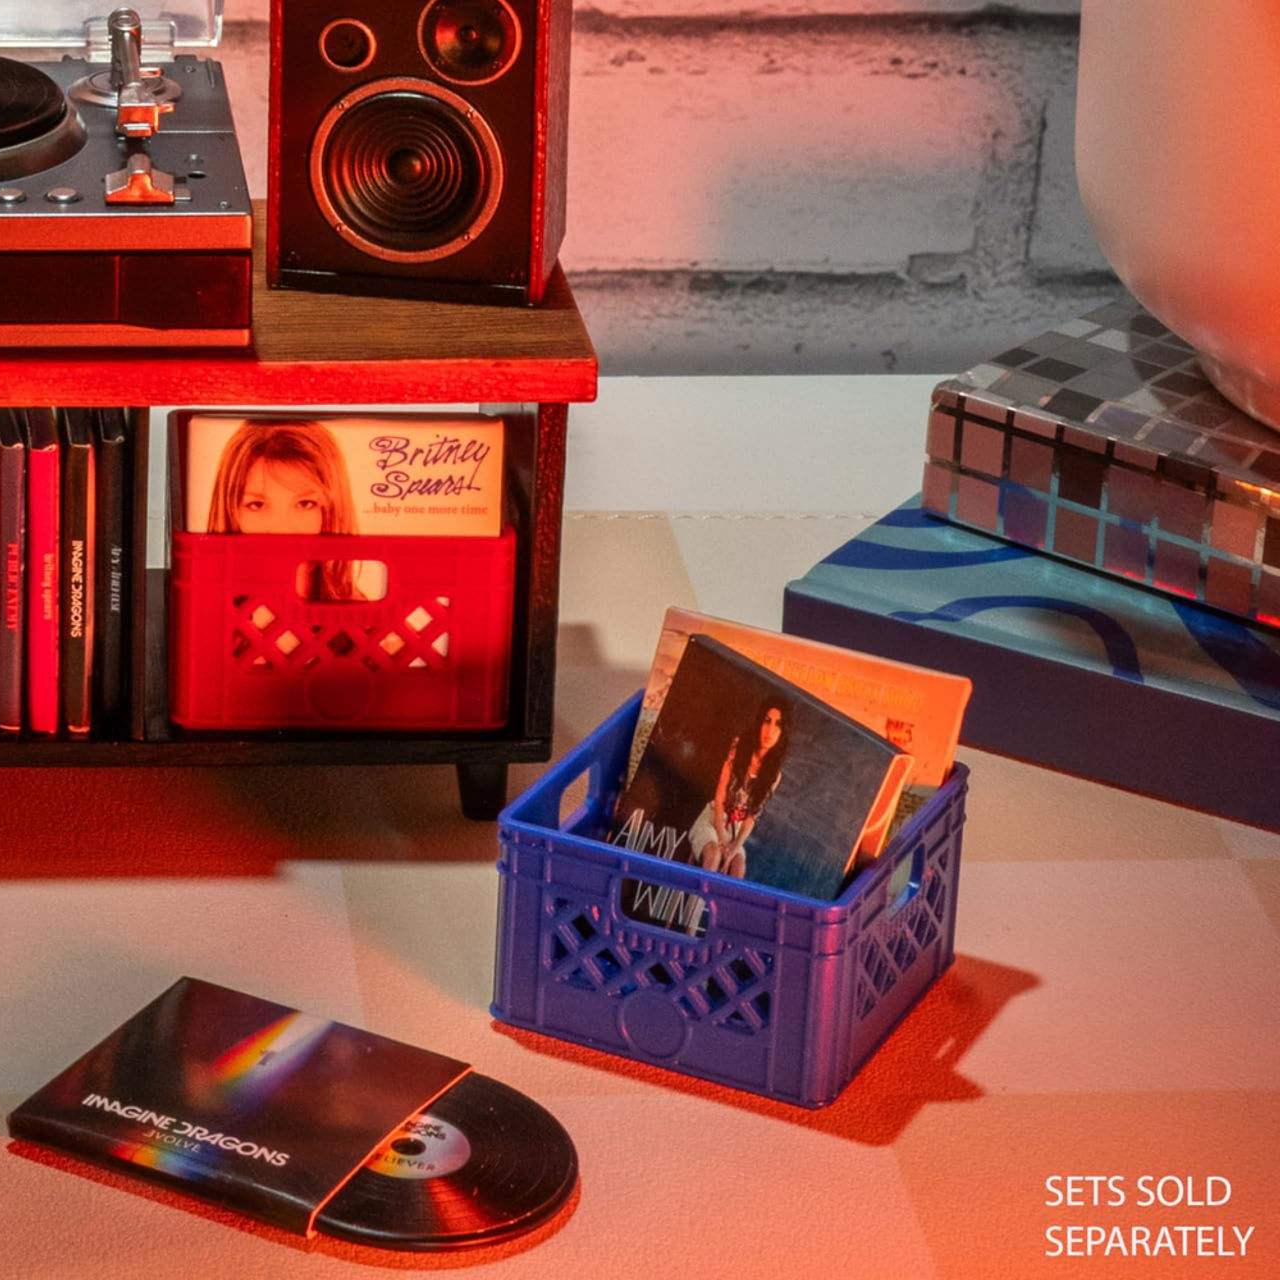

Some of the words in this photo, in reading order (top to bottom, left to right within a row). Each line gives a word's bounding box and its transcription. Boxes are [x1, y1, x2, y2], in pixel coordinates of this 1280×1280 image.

[368, 434, 491, 490] Britney
[370, 470, 472, 500] Spears
[403, 506, 425, 514] one
[428, 506, 458, 514] more
[461, 504, 488, 514] time
[71, 540, 83, 583] IMAGINE
[70, 584, 82, 637] DRAGONS
[82, 1093, 176, 1130] IMAGINE
[173, 1121, 290, 1166] DRAGONS
